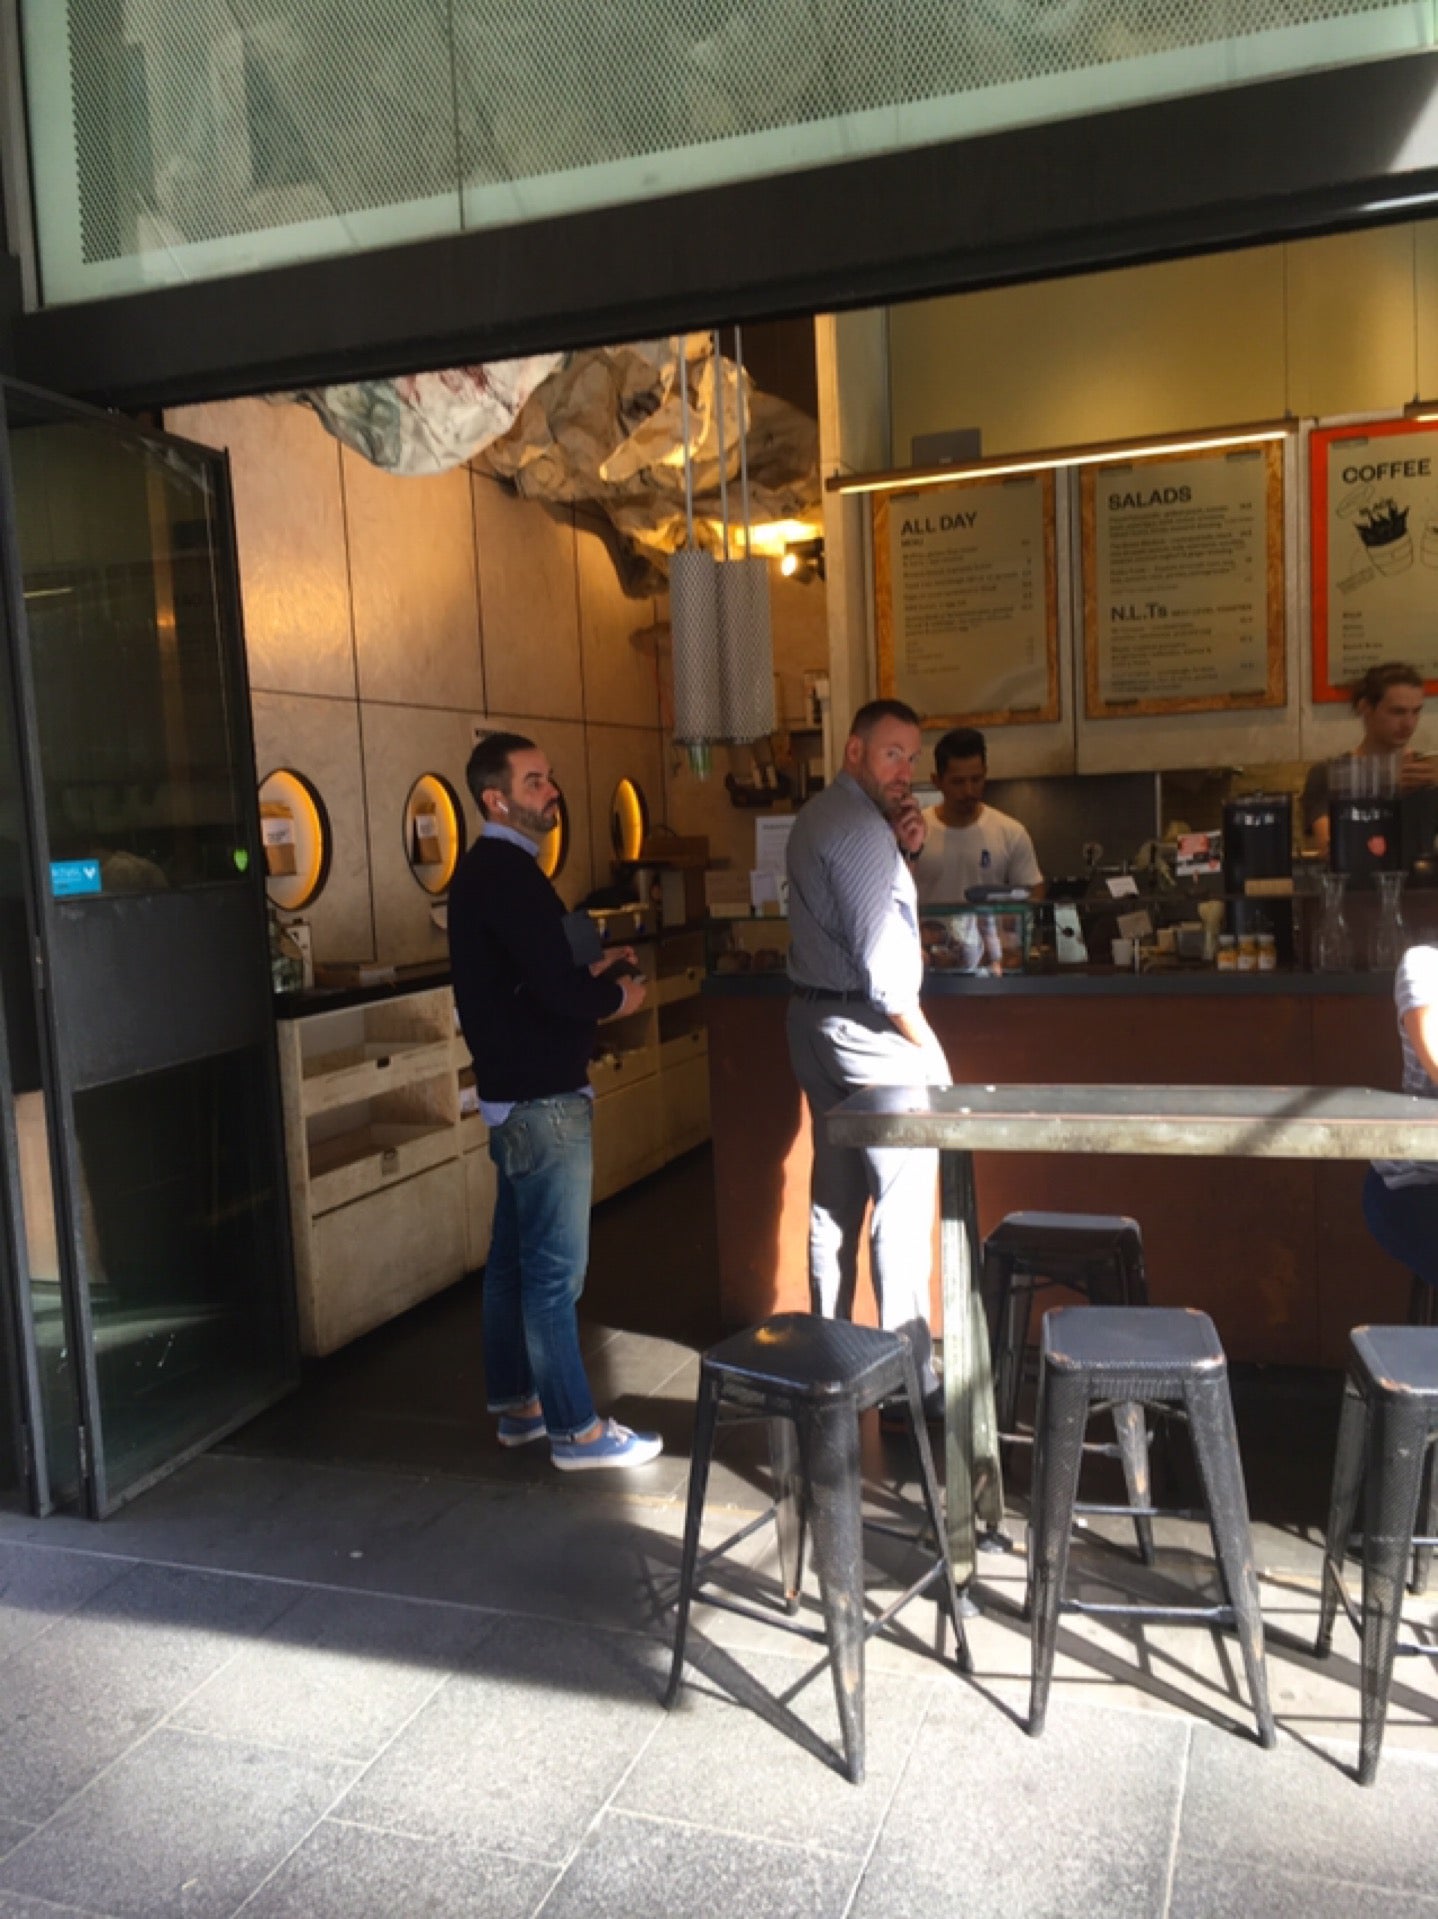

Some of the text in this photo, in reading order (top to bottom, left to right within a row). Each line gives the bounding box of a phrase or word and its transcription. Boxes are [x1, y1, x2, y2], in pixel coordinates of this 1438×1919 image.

[1342, 457, 1432, 484] COFFEE
[1109, 485, 1192, 511] SALADS
[901, 511, 978, 536] ALL DAY
